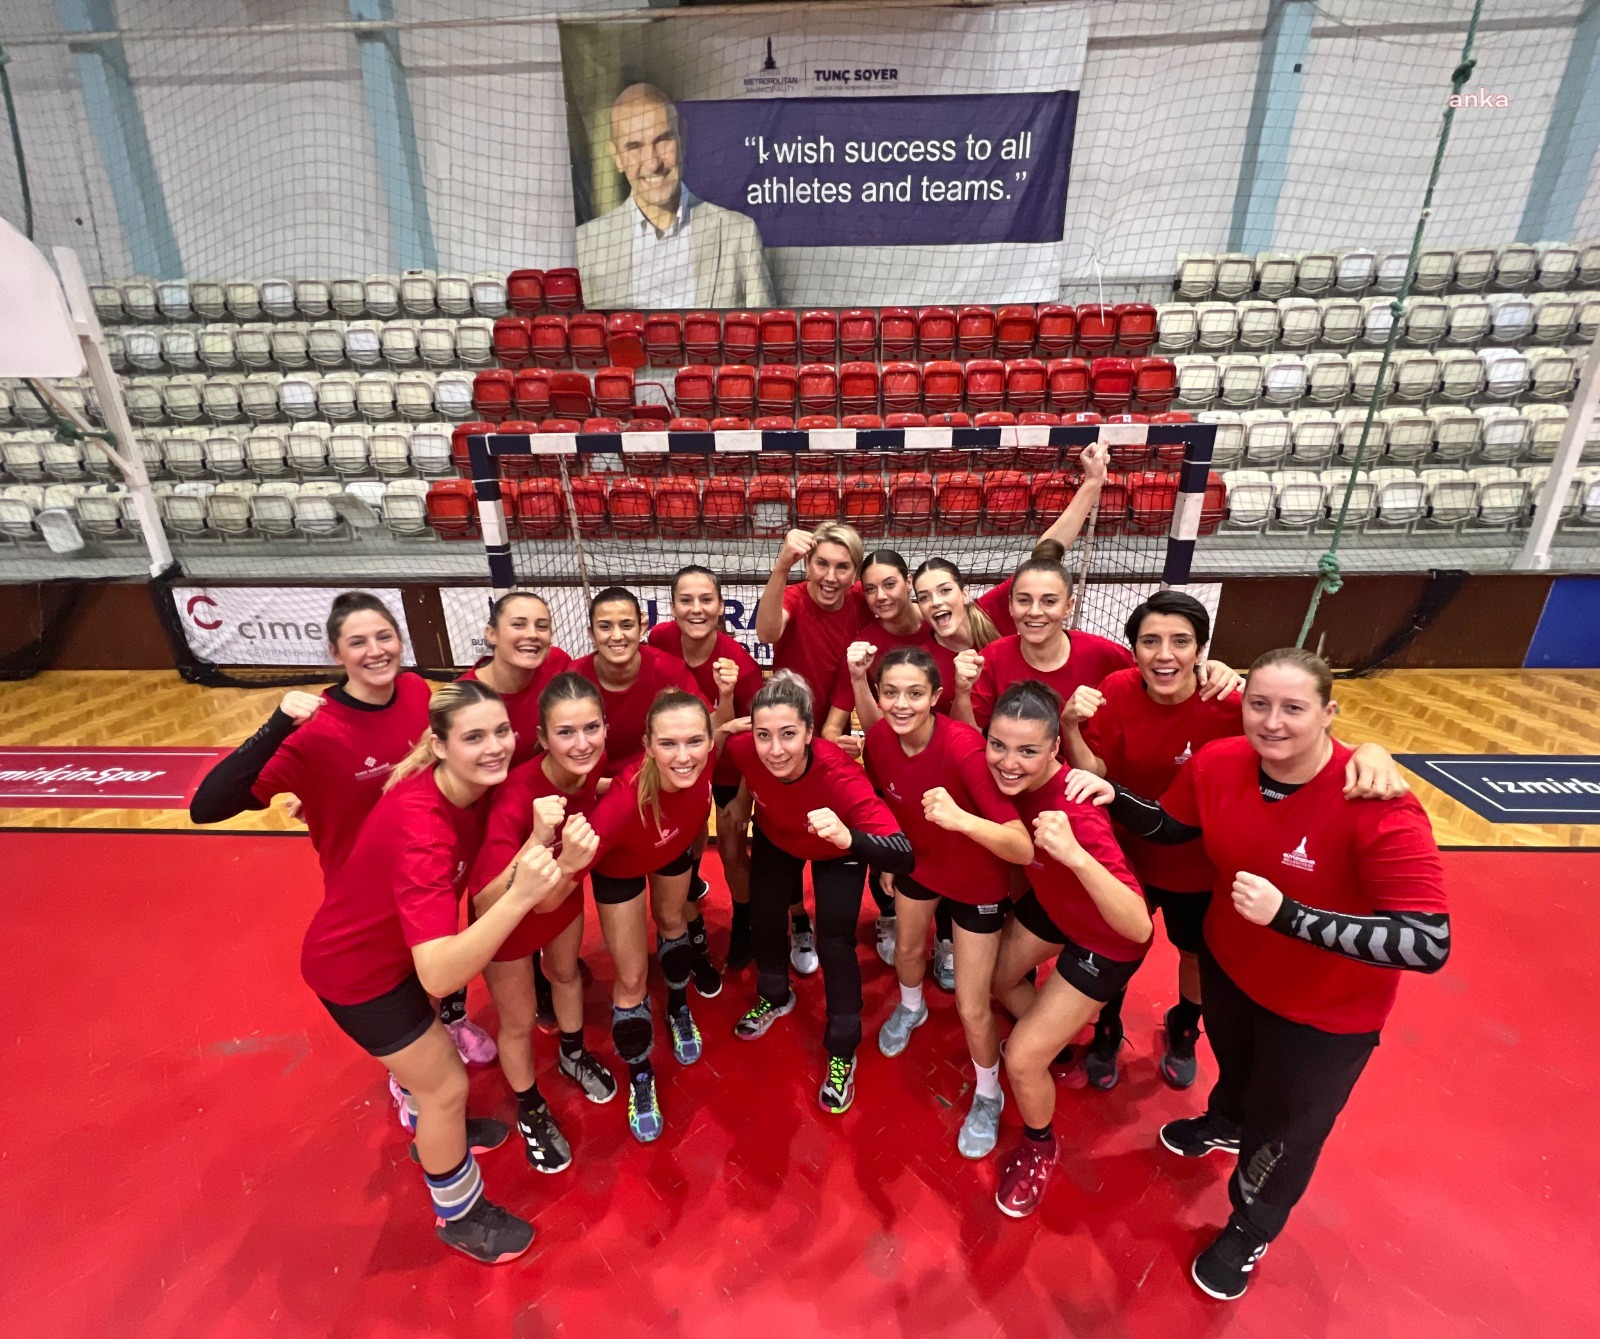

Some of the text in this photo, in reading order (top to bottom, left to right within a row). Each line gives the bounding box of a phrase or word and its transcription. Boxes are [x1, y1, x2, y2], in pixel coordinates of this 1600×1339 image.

[743, 77, 798, 86] METROPOLITAN
[814, 69, 898, 84] TUNÇ SOYER
[773, 135, 834, 163] wish
[844, 138, 956, 163] success
[966, 134, 991, 161] to
[1000, 132, 1031, 160] all
[746, 177, 852, 204] athletes
[861, 176, 911, 202] and
[1481, 777, 1600, 794] izmirb
